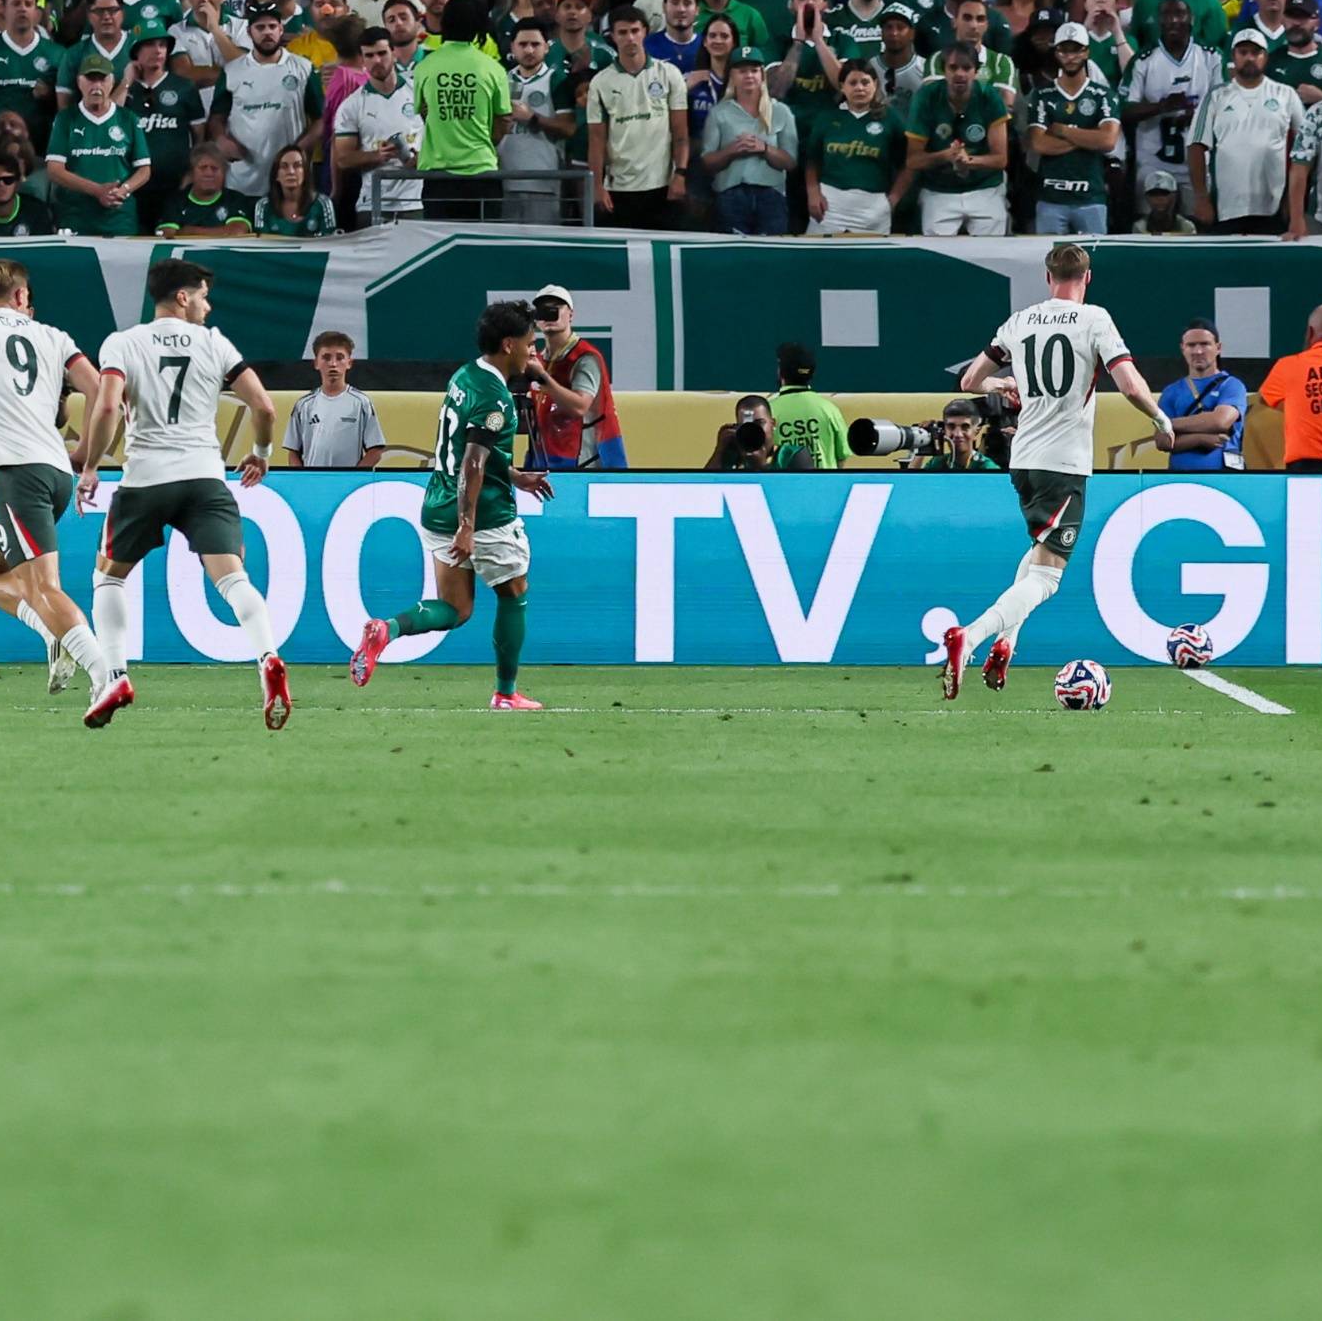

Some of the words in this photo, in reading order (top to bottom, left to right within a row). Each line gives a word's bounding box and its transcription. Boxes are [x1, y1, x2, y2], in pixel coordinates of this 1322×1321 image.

[437, 72, 477, 88] CSC
[437, 89, 477, 106] EVENT
[438, 105, 477, 122] STAFF
[1027, 310, 1079, 326] PALMER
[152, 332, 192, 348] NETO
[5, 333, 38, 397] 9
[1021, 332, 1076, 400] 10
[158, 355, 191, 425] 7
[778, 418, 820, 438] CSC
